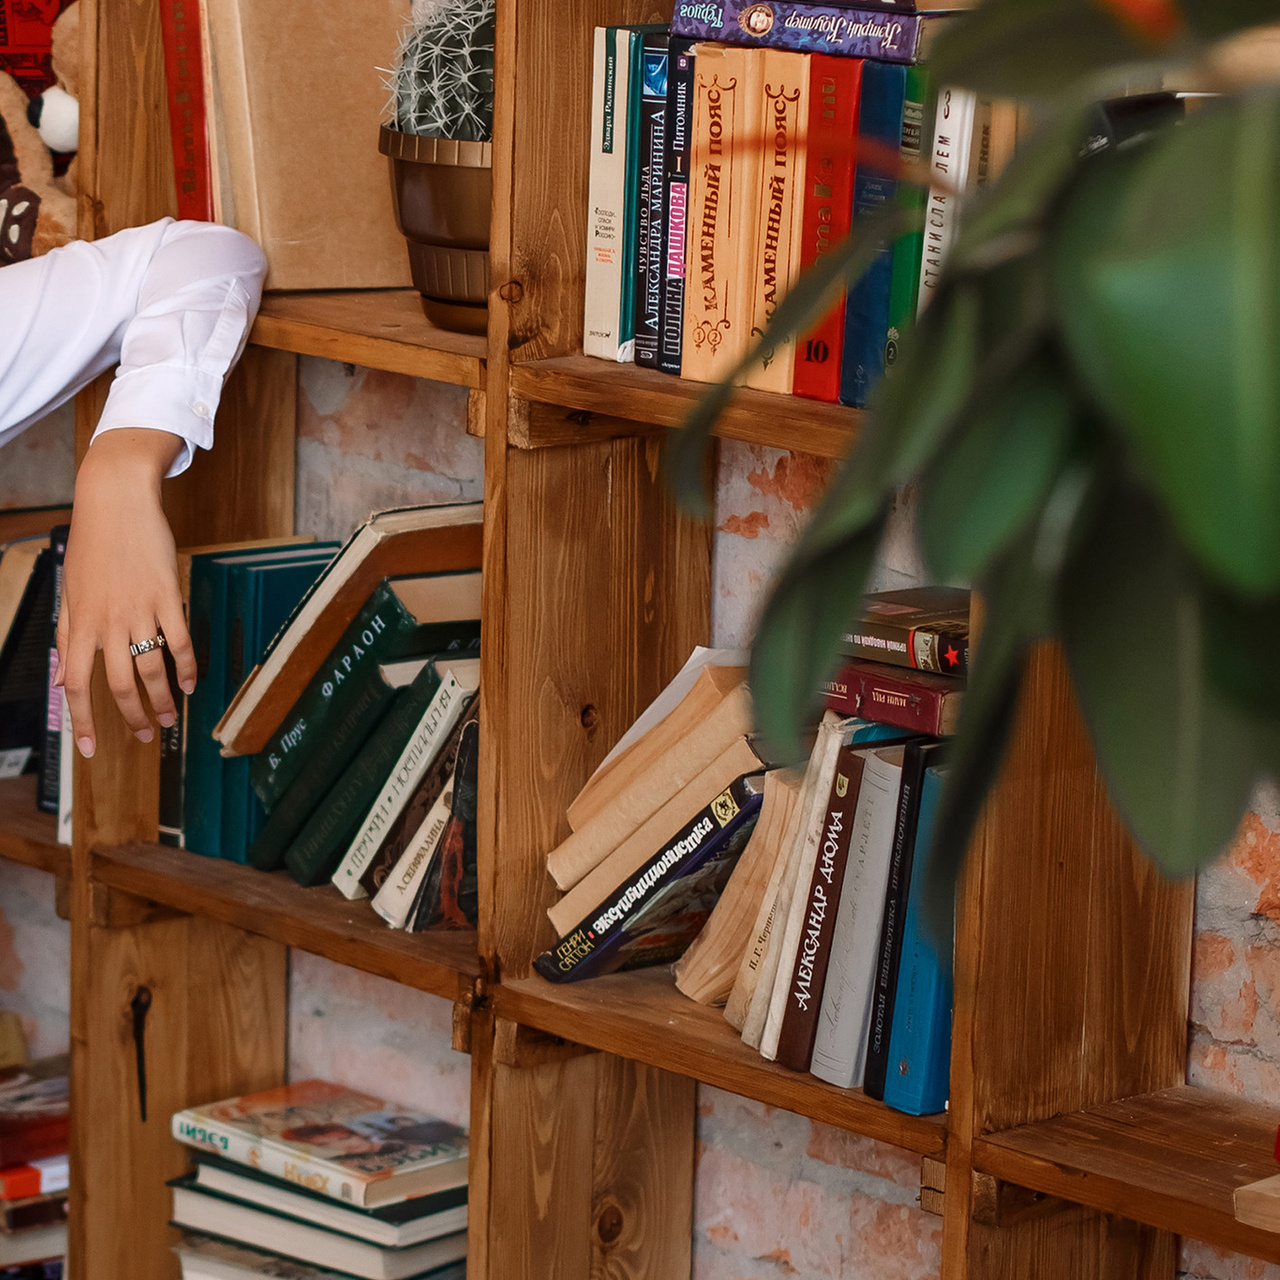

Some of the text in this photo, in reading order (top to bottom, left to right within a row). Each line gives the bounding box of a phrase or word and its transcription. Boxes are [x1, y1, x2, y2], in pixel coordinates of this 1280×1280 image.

[679, 2, 724, 29] Герцог
[784, 9, 903, 49] Кэтрин Коултер
[602, 54, 615, 151] Эдвард Радзинский
[943, 89, 951, 119] 3
[638, 164, 651, 273] ЧУВСТВО ЛЬДА
[662, 81, 688, 355] ПОЛИНА ДАШКОВА Питомник
[700, 89, 723, 312] КАМЕННЫЙ ПОЯС
[763, 99, 787, 324] КАМЕННЫЙ ПОЯС
[922, 134, 952, 289] СТАНИСЛА ЛЕМ
[805, 339, 829, 364] 10
[319, 614, 387, 698] ФАРАОН
[267, 717, 309, 771] Б. Прус
[556, 929, 586, 960] ГЕНРИ
[558, 939, 595, 971] САТТОН
[793, 810, 844, 1011] АЛЕКСАНДР ДЮМА
[872, 993, 887, 1055] ЗОЛОТАЯ
[880, 898, 897, 989] БИБЛИОТЕКА
